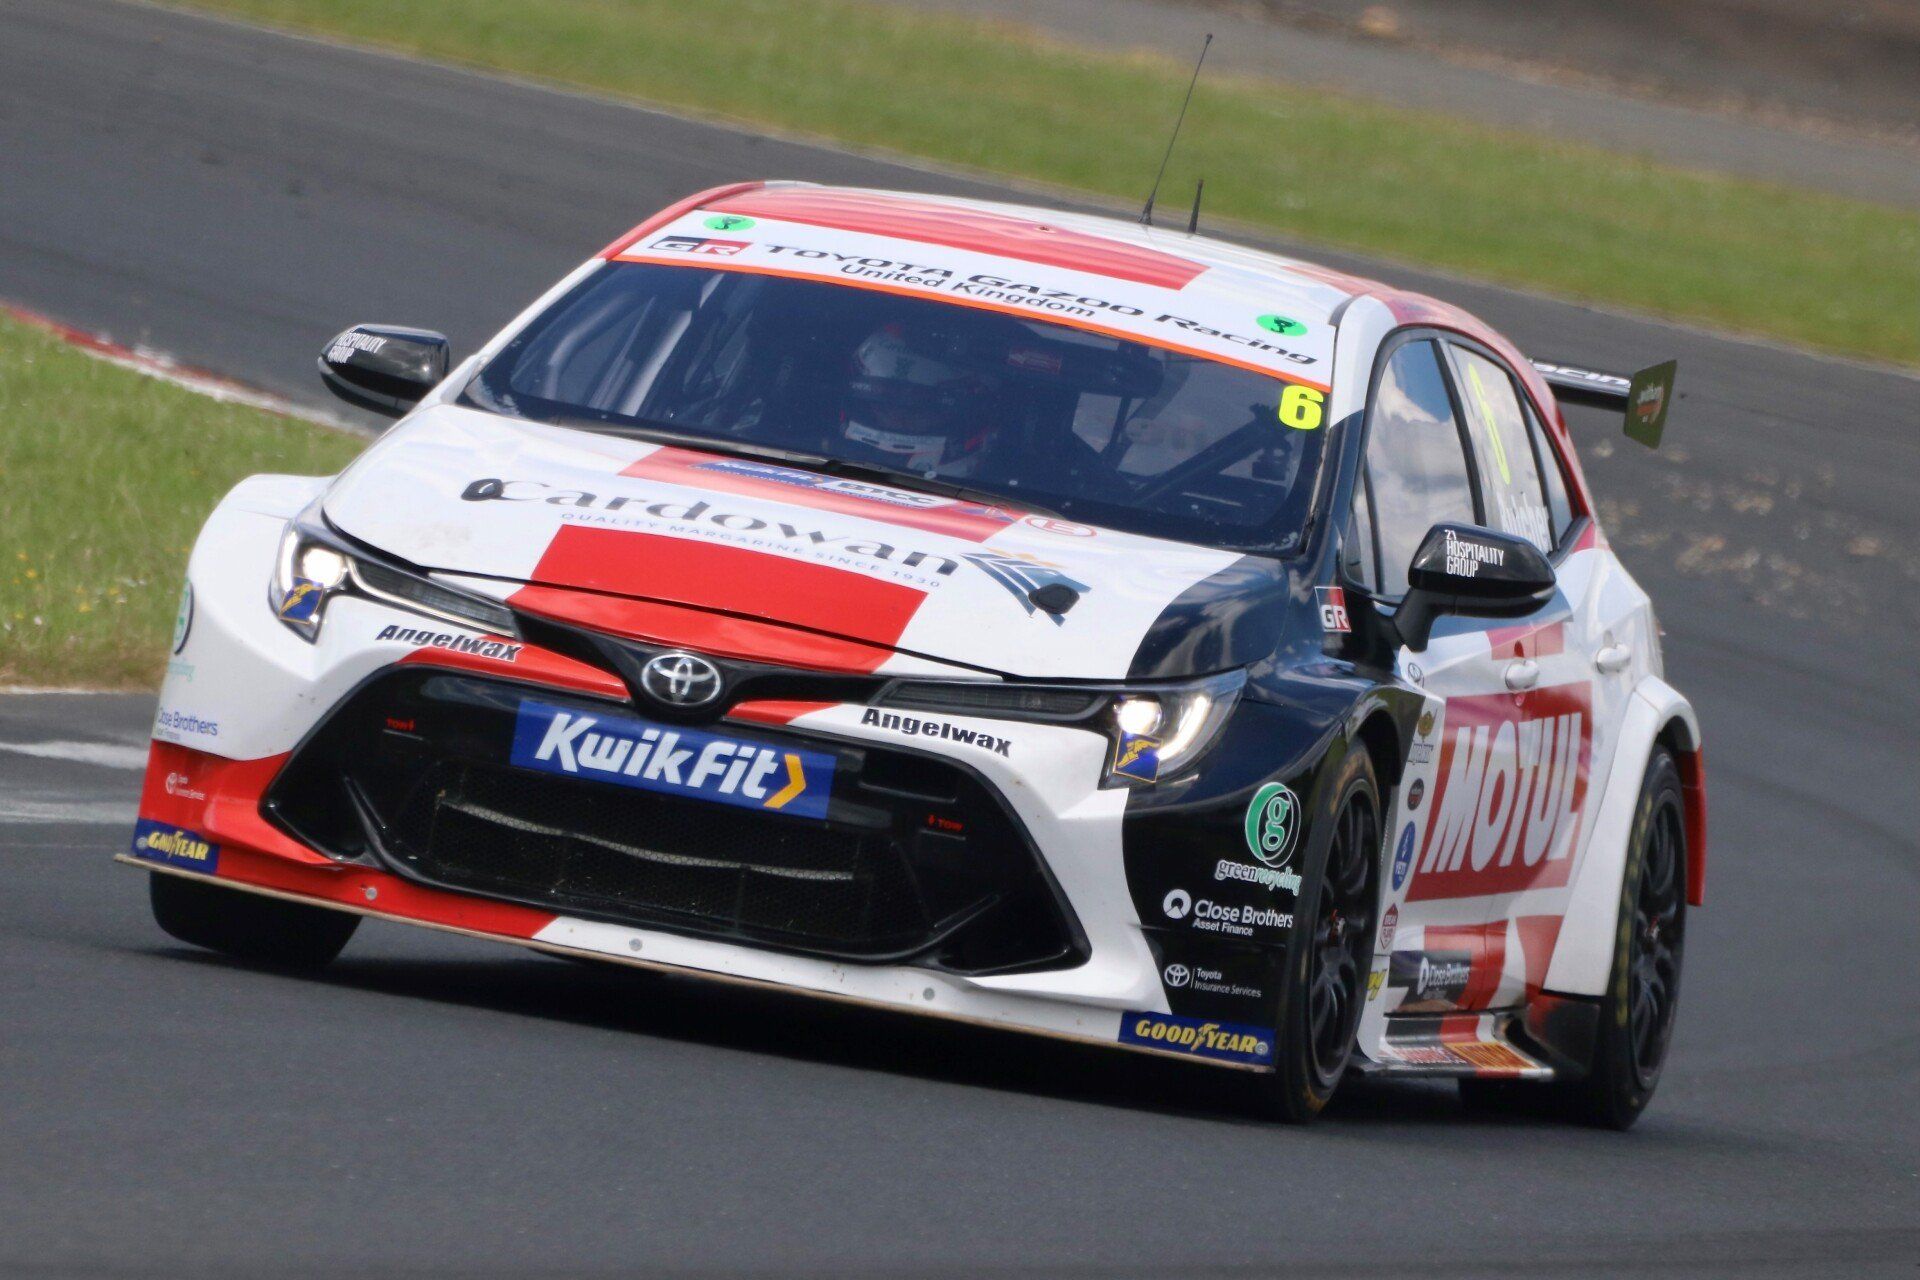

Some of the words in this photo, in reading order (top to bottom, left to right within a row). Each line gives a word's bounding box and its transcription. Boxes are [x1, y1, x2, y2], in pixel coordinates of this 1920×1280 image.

[764, 243, 954, 279] TOYOTA
[968, 273, 1145, 318] GAZOO
[1155, 313, 1318, 365] Racing
[841, 263, 946, 288] United
[951, 280, 1096, 319] Kingdom
[1278, 385, 1324, 430] 6
[560, 512, 659, 529] QUALITY
[668, 525, 800, 558] MARGARINE
[815, 551, 878, 571] SINCE
[1446, 540, 1504, 567] HOSPITALITY
[1446, 556, 1479, 578] GROUP
[1320, 605, 1349, 630] GR
[375, 623, 524, 664] Angelwax
[860, 707, 1012, 758] Angelwax
[1420, 711, 1583, 874] MOTUL
[1192, 918, 1220, 932] Asset
[1221, 921, 1254, 936] Finance
[1194, 899, 1239, 923] Close
[1241, 905, 1294, 929] Brothers
[1195, 979, 1230, 995] Insurance
[1230, 984, 1262, 998] Services
[1197, 967, 1223, 982] Toyota
[1135, 1018, 1258, 1054] GOODYEAR
